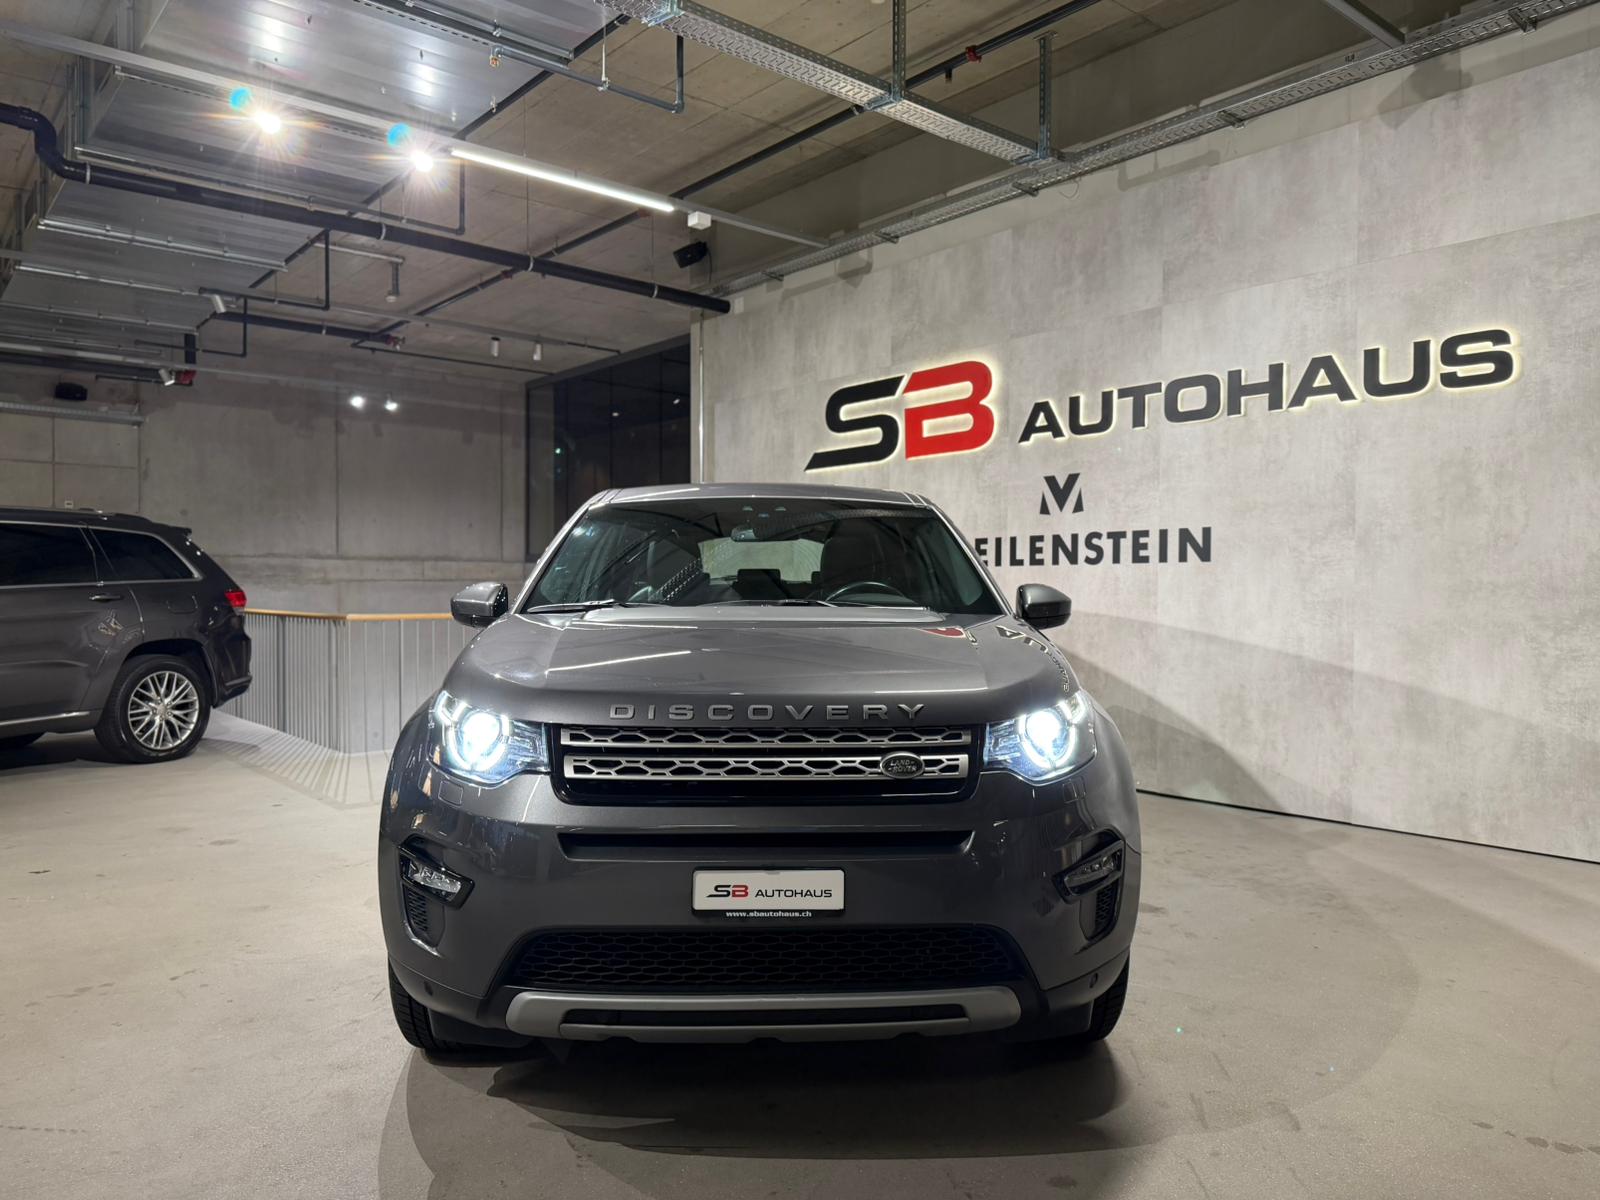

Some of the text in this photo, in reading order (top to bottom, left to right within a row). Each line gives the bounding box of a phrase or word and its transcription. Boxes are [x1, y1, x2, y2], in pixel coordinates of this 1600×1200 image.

[804, 329, 1513, 471] SB AUTOHAUS
[975, 526, 1212, 567] EILENSTEIN
[609, 703, 926, 721] DISCOVERY
[706, 884, 833, 898] SB AUTOHAUS
